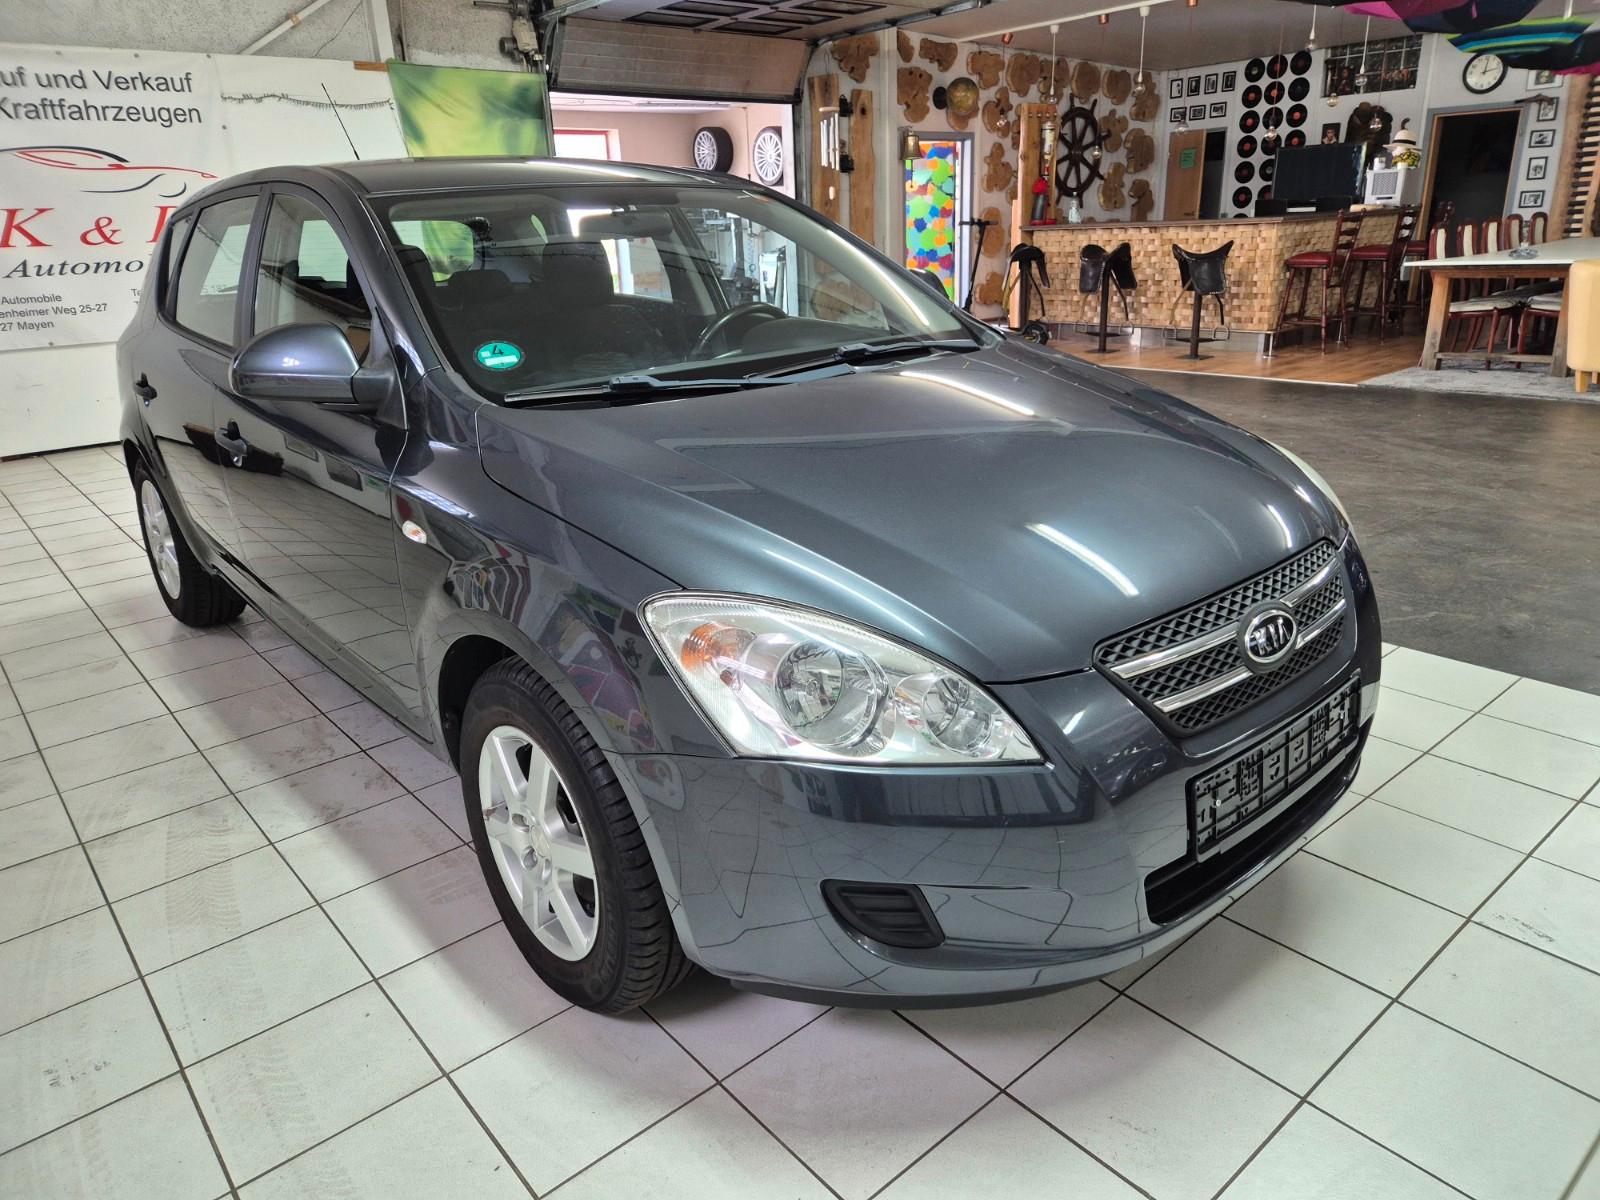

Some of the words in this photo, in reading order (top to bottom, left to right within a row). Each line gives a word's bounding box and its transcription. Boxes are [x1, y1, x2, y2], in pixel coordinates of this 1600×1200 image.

[0, 65, 26, 87] uf
[34, 69, 88, 89] und
[92, 69, 192, 92] Verkauf
[0, 207, 55, 248] K
[79, 216, 125, 246] &
[2, 254, 153, 279] Automo
[1, 293, 62, 305] Automobile
[52, 305, 77, 316] Weg
[79, 303, 108, 314] 25-27
[17, 320, 55, 331] Mayen
[492, 344, 504, 356] 4
[1252, 616, 1291, 656] KIA
